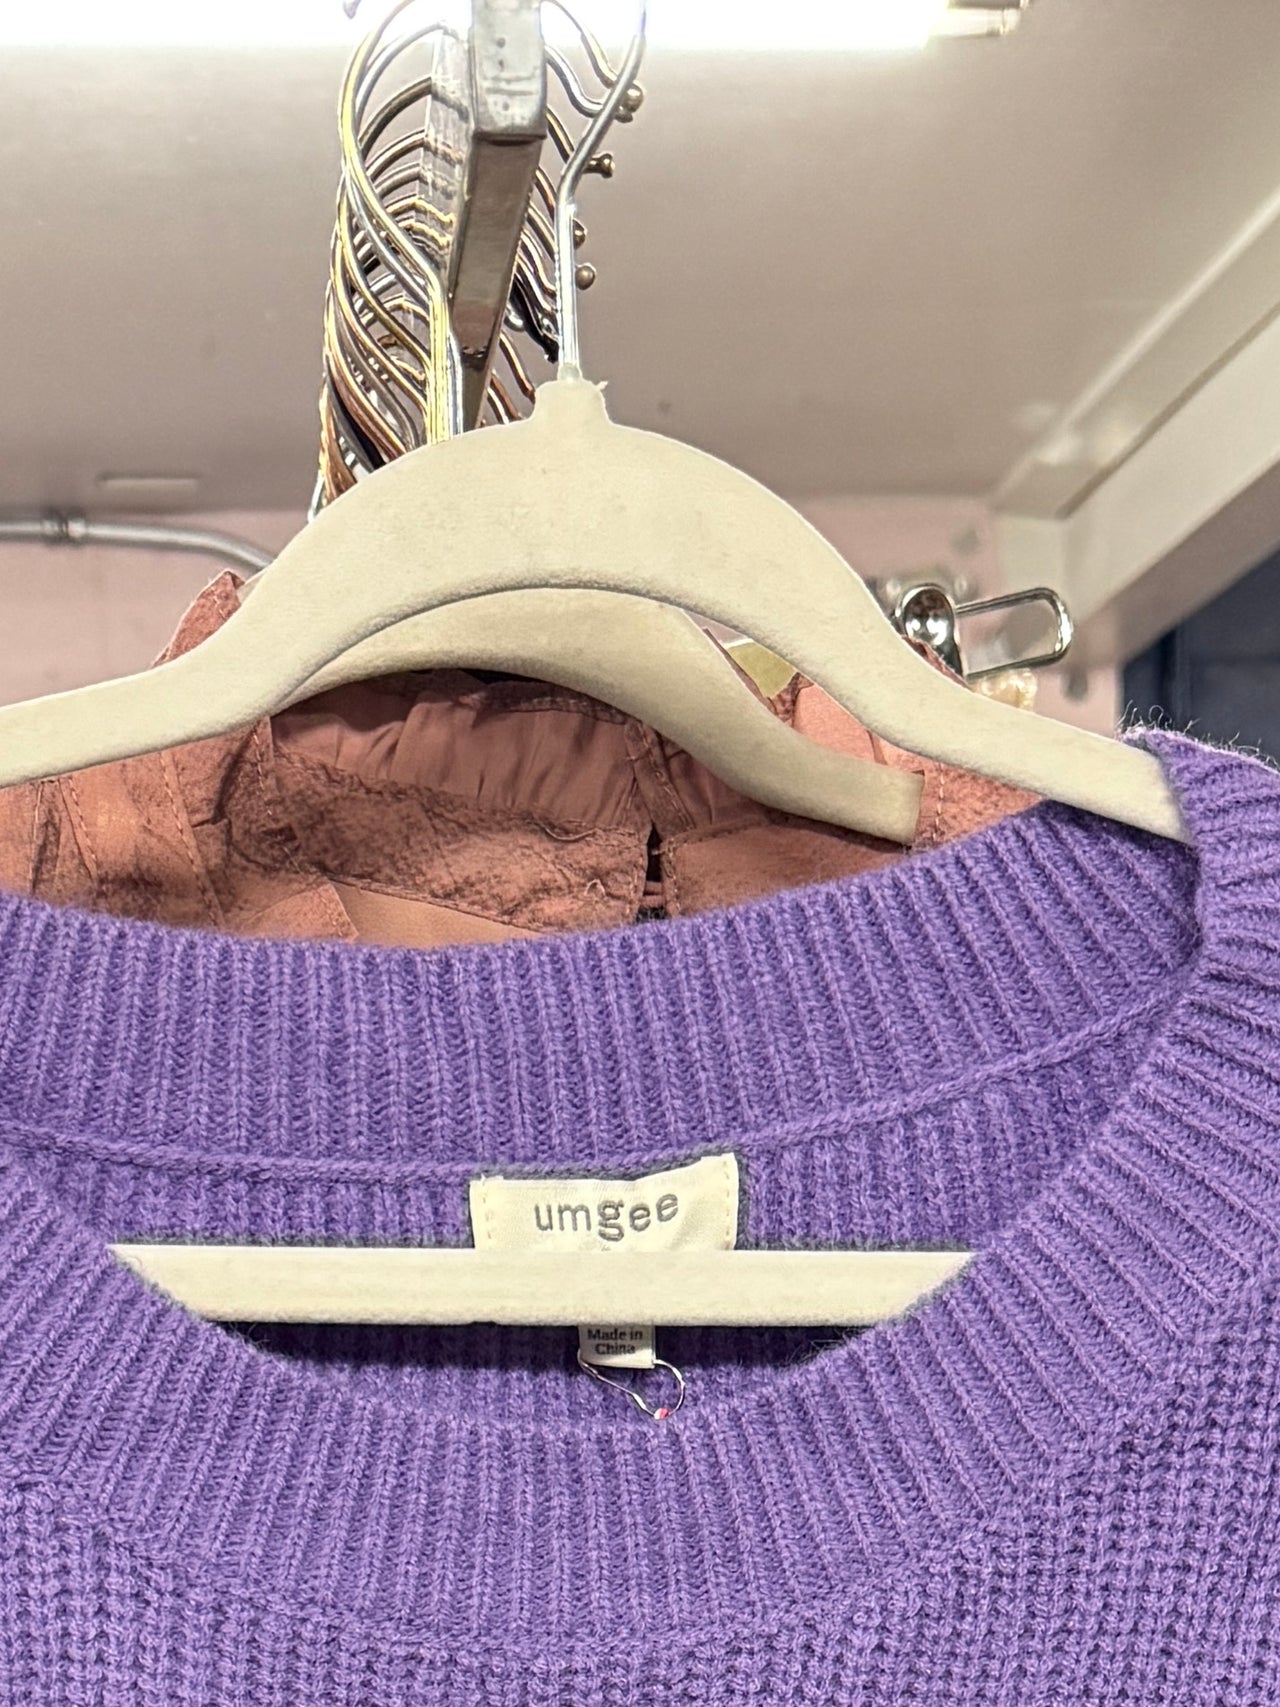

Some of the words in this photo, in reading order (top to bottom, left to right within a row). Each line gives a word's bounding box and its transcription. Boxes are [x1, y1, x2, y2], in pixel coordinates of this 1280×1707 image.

[534, 1193, 679, 1242] umgee
[587, 1328, 626, 1341] Made
[630, 1327, 643, 1341] in
[595, 1343, 636, 1355] China
